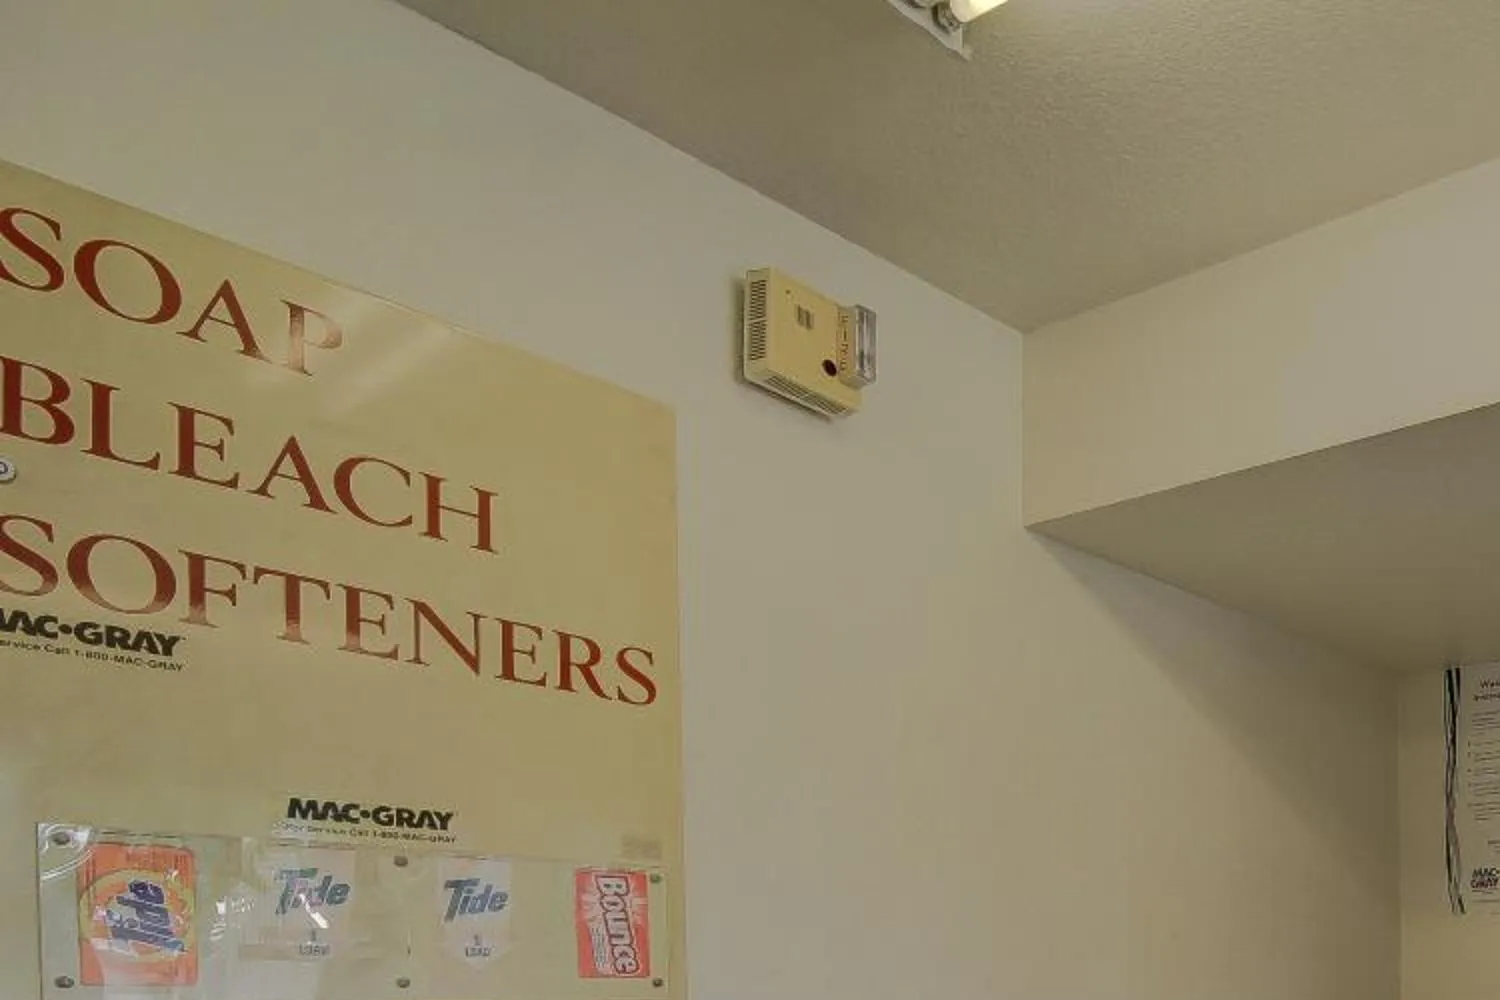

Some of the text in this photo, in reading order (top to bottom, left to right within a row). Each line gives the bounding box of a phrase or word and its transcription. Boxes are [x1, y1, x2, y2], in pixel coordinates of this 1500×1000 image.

[0, 207, 344, 377] SOAP
[0, 355, 500, 555] BLEACH
[0, 514, 657, 706] SOFTENERS
[274, 868, 350, 915] Tide
[444, 878, 508, 923] Tide
[595, 874, 641, 976] Bounce
